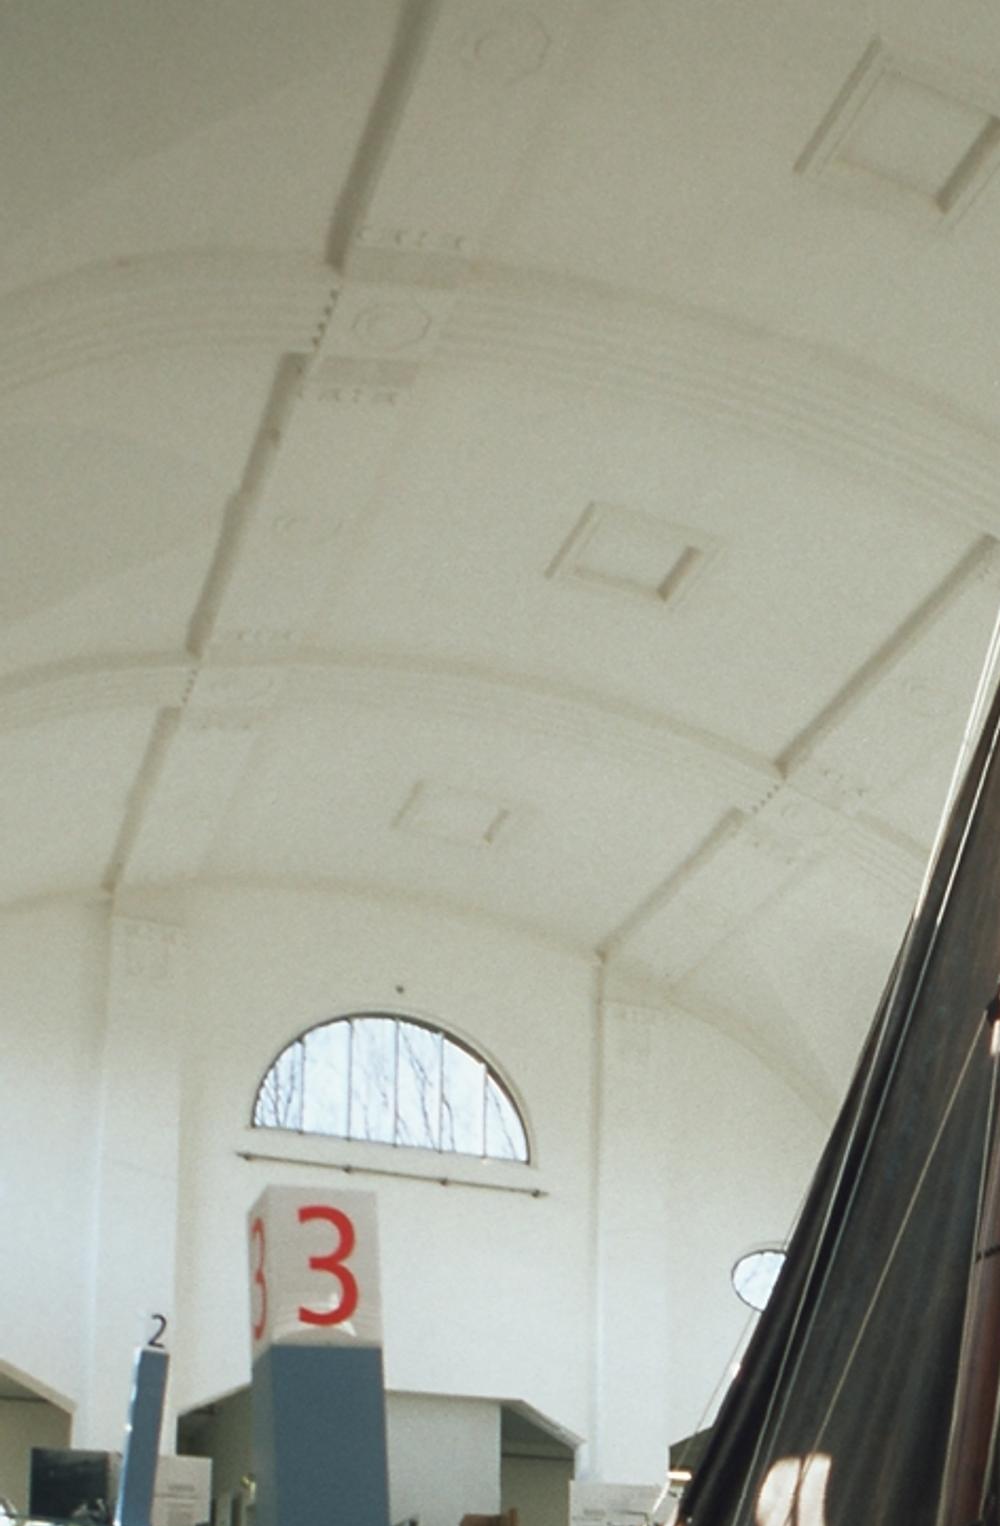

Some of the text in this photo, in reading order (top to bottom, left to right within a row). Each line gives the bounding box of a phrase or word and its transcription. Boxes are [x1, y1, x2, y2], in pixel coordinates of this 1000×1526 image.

[253, 1217, 266, 1340] 3
[298, 1205, 357, 1326] 3
[148, 1313, 166, 1348] 2
